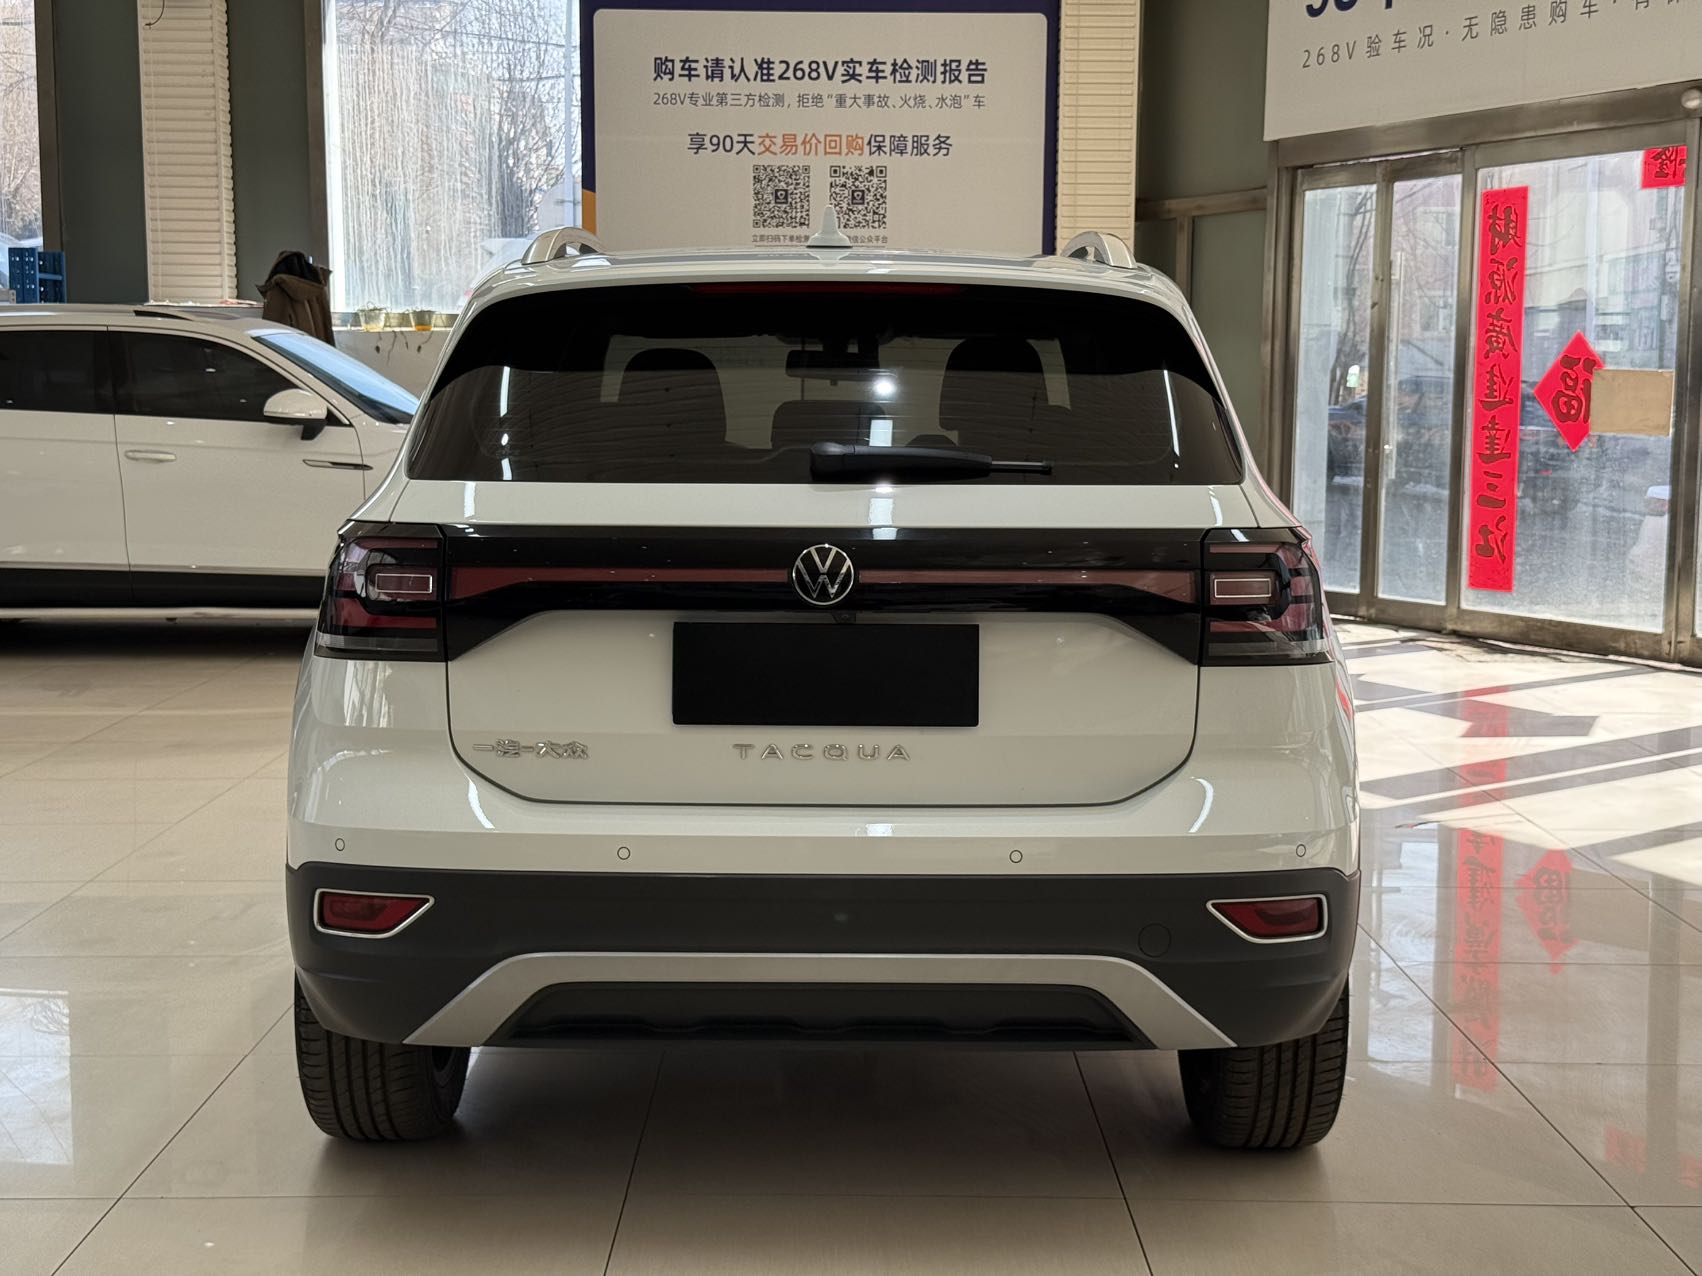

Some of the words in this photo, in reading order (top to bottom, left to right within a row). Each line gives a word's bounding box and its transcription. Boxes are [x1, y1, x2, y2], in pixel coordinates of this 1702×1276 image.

[653, 56, 988, 85] 购车请认准268V实车检测报告
[687, 132, 953, 157] 享90天交易价回购保障服务
[732, 743, 911, 761] TACQUA
